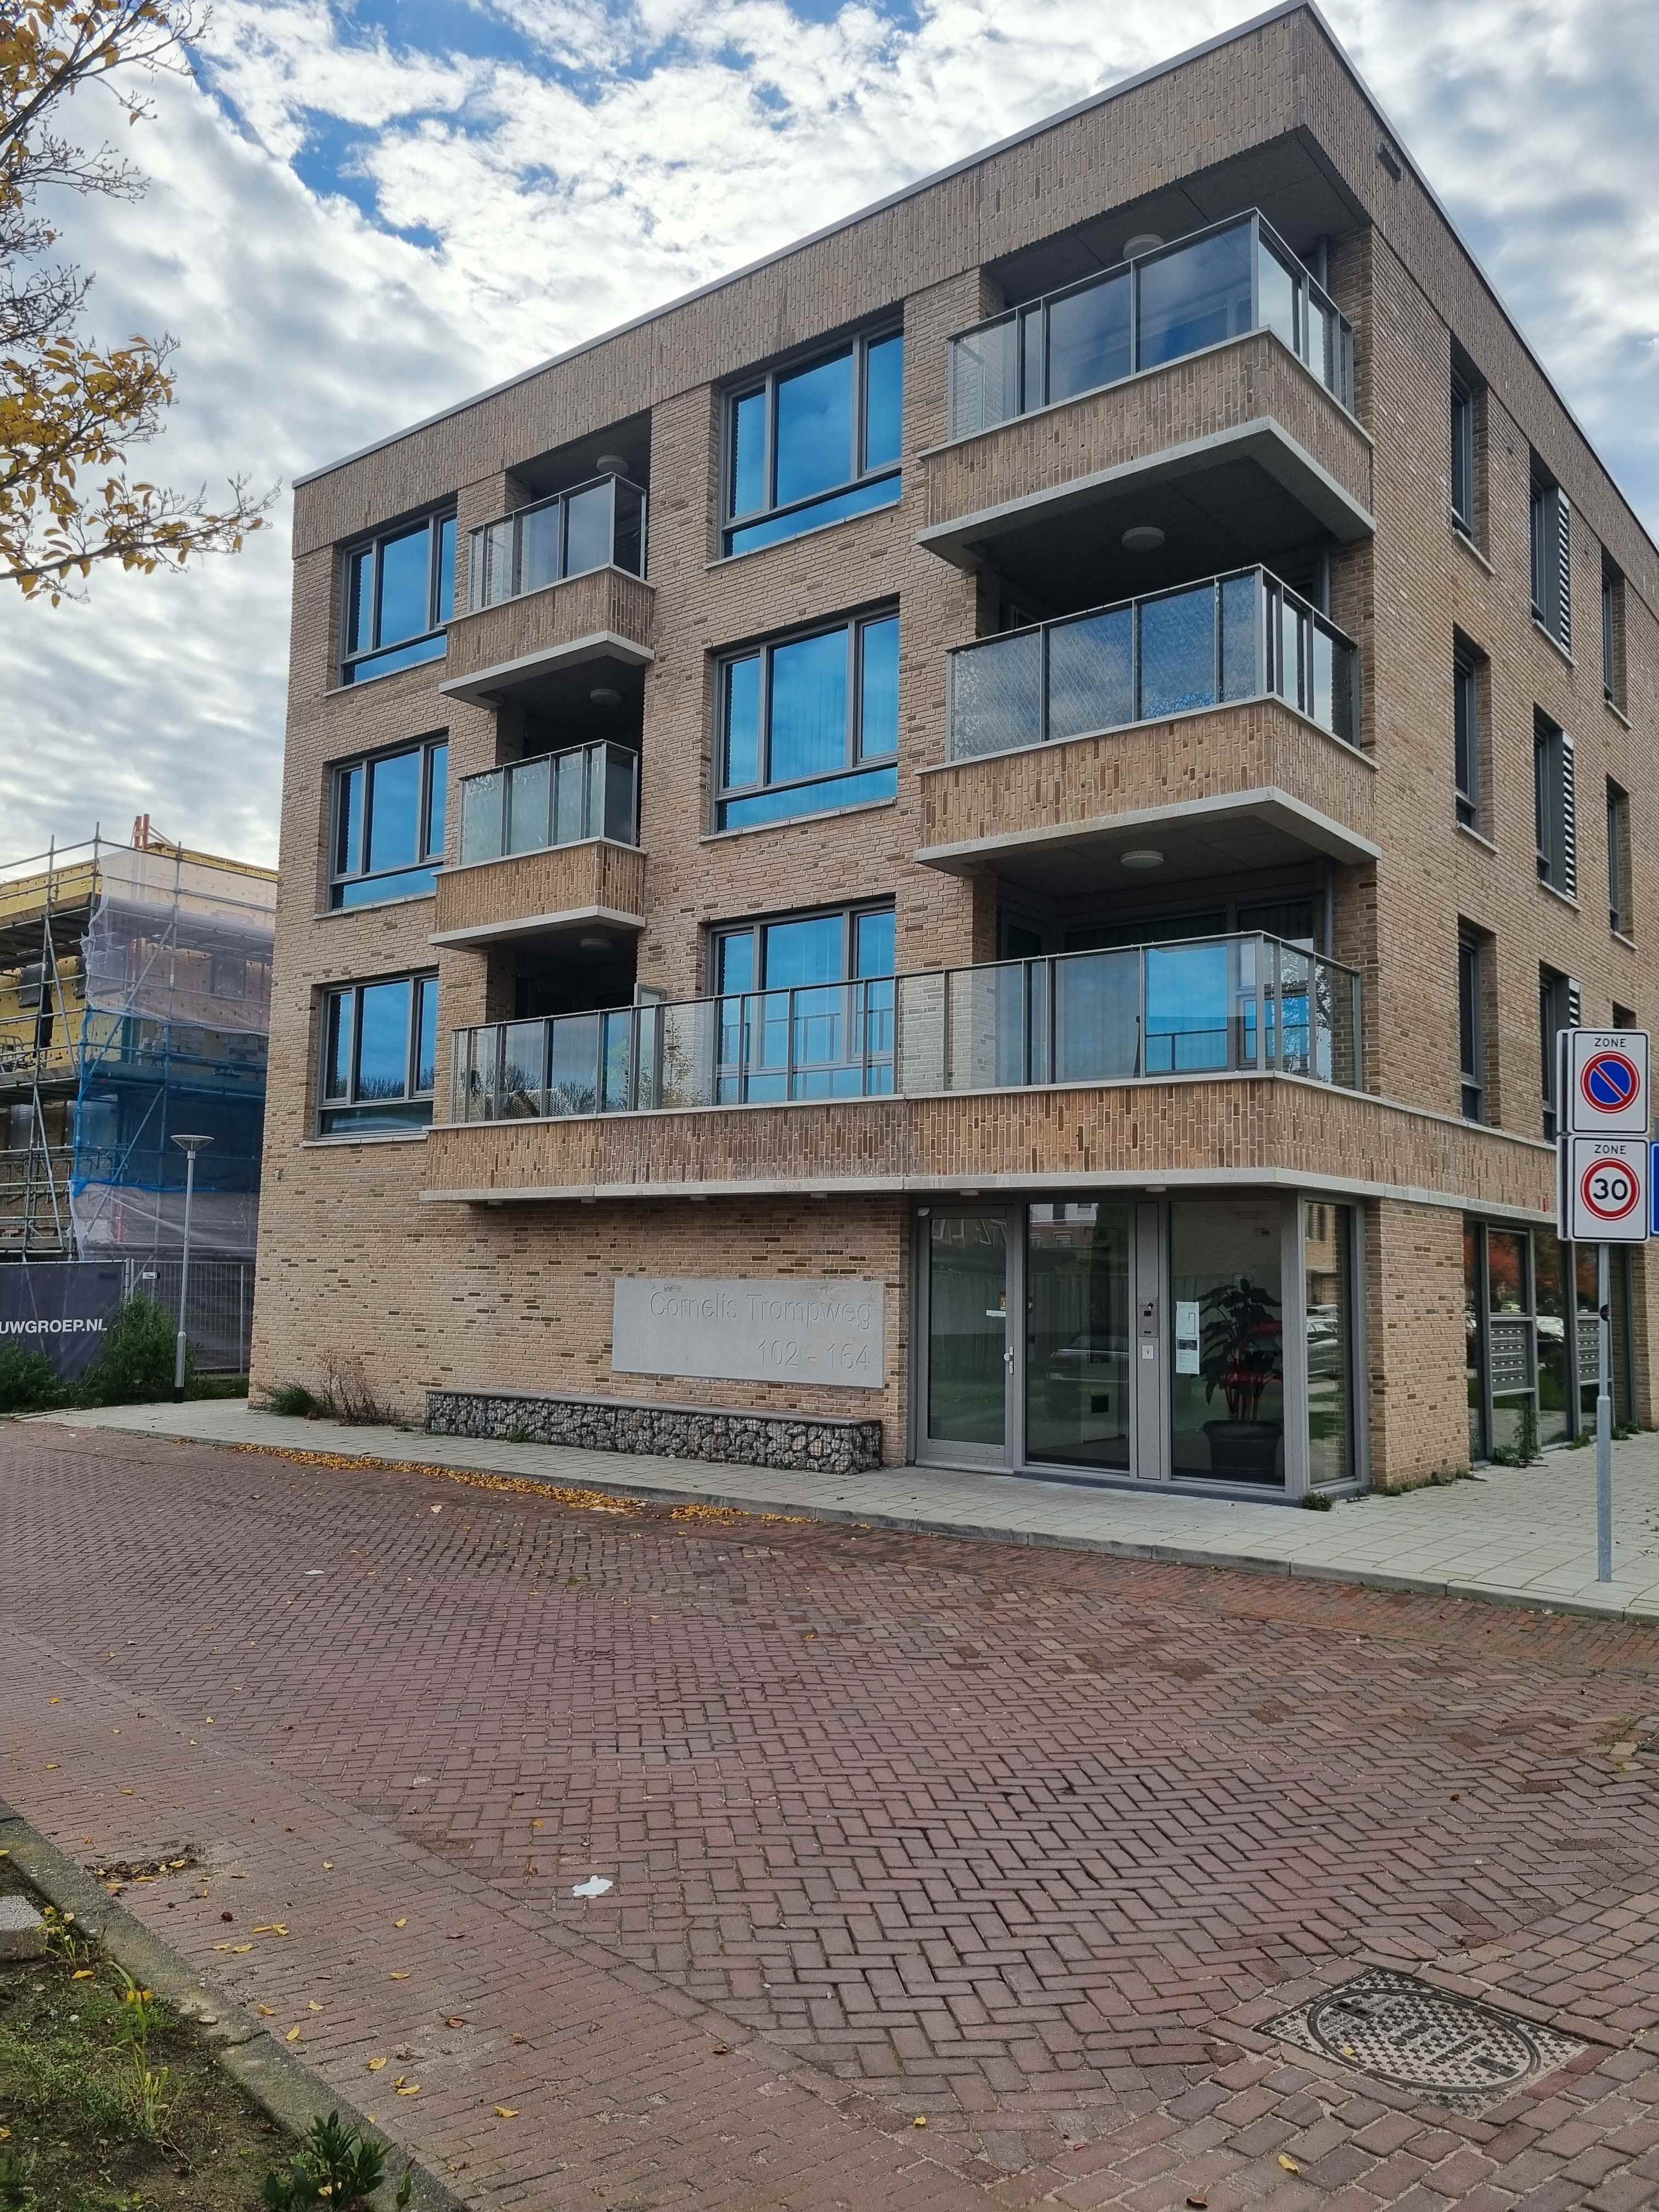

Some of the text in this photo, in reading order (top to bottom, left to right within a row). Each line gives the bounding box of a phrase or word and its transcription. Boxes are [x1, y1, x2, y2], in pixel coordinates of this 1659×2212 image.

[1594, 1038, 1627, 1047] ZONE
[1594, 1144, 1627, 1155] ZONE
[1593, 1178, 1628, 1201] 30
[650, 1291, 871, 1330] Cornelis Trompweg
[758, 1340, 799, 1368] 102
[827, 1342, 872, 1372] 164
